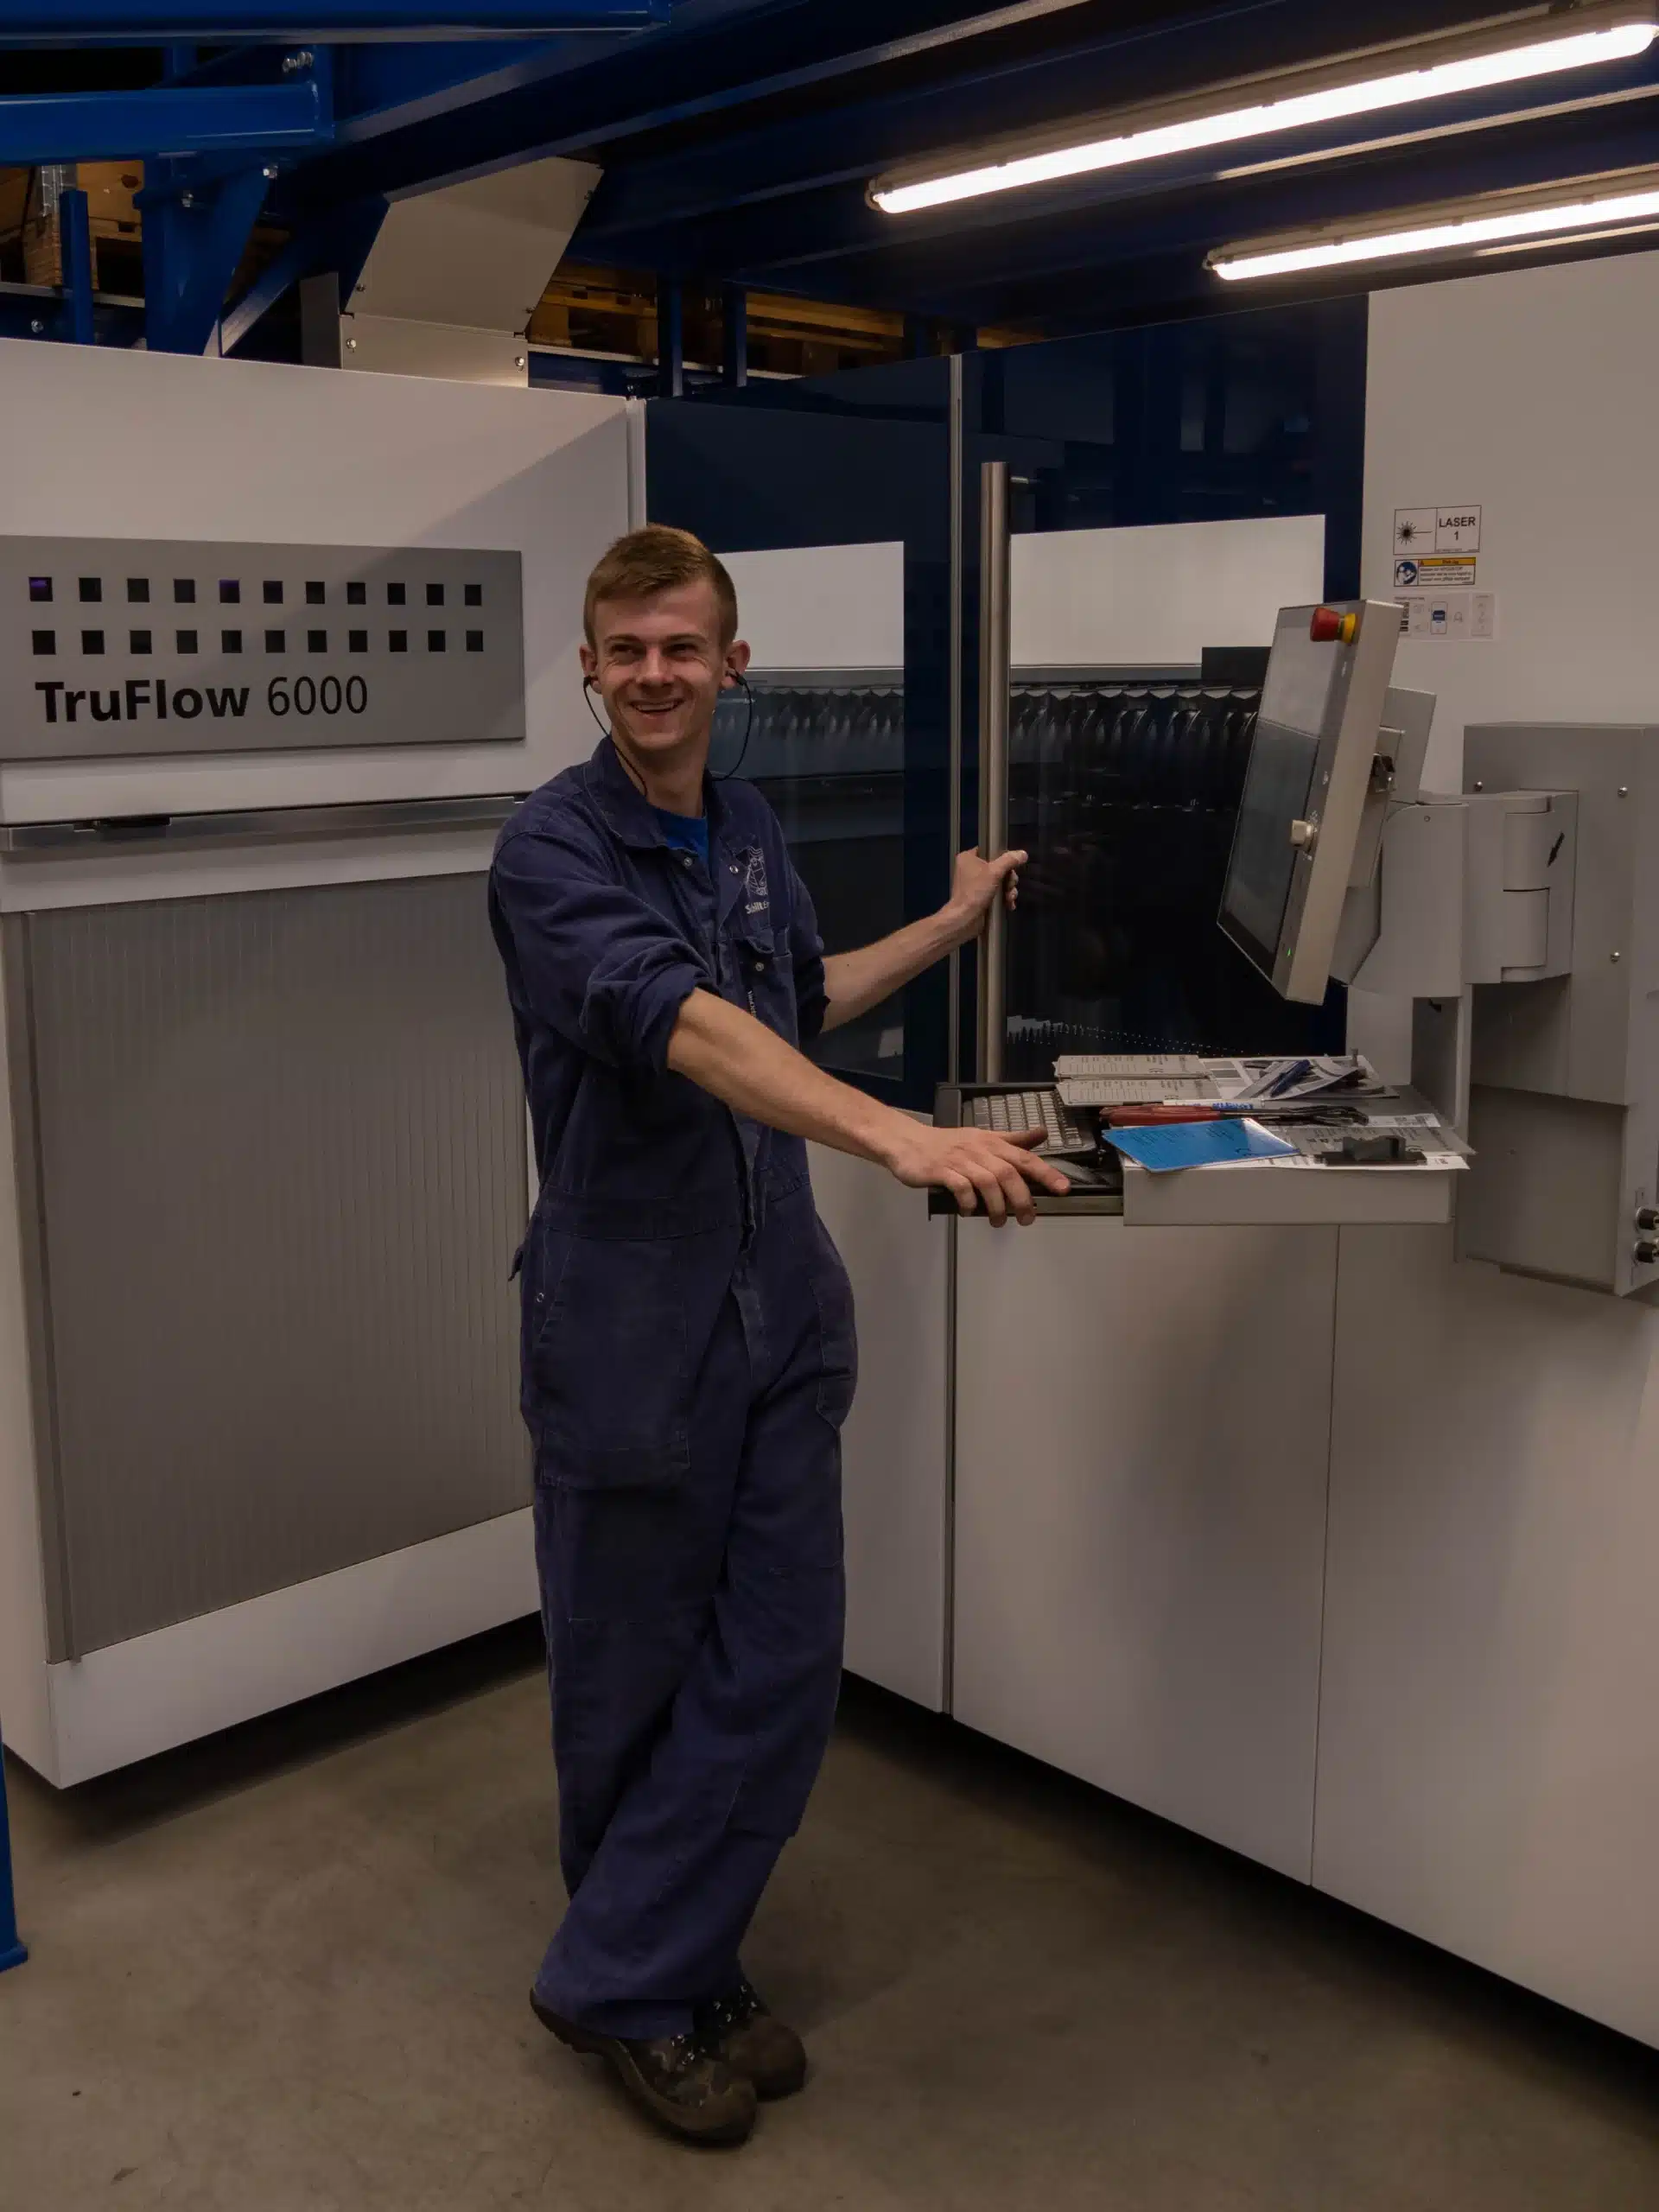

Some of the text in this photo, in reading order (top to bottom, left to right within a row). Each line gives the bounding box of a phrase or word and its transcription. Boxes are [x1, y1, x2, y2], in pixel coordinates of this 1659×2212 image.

[1439, 517, 1476, 527] LASER
[1454, 531, 1459, 541] 1
[35, 675, 368, 722] TruFlow 6000
